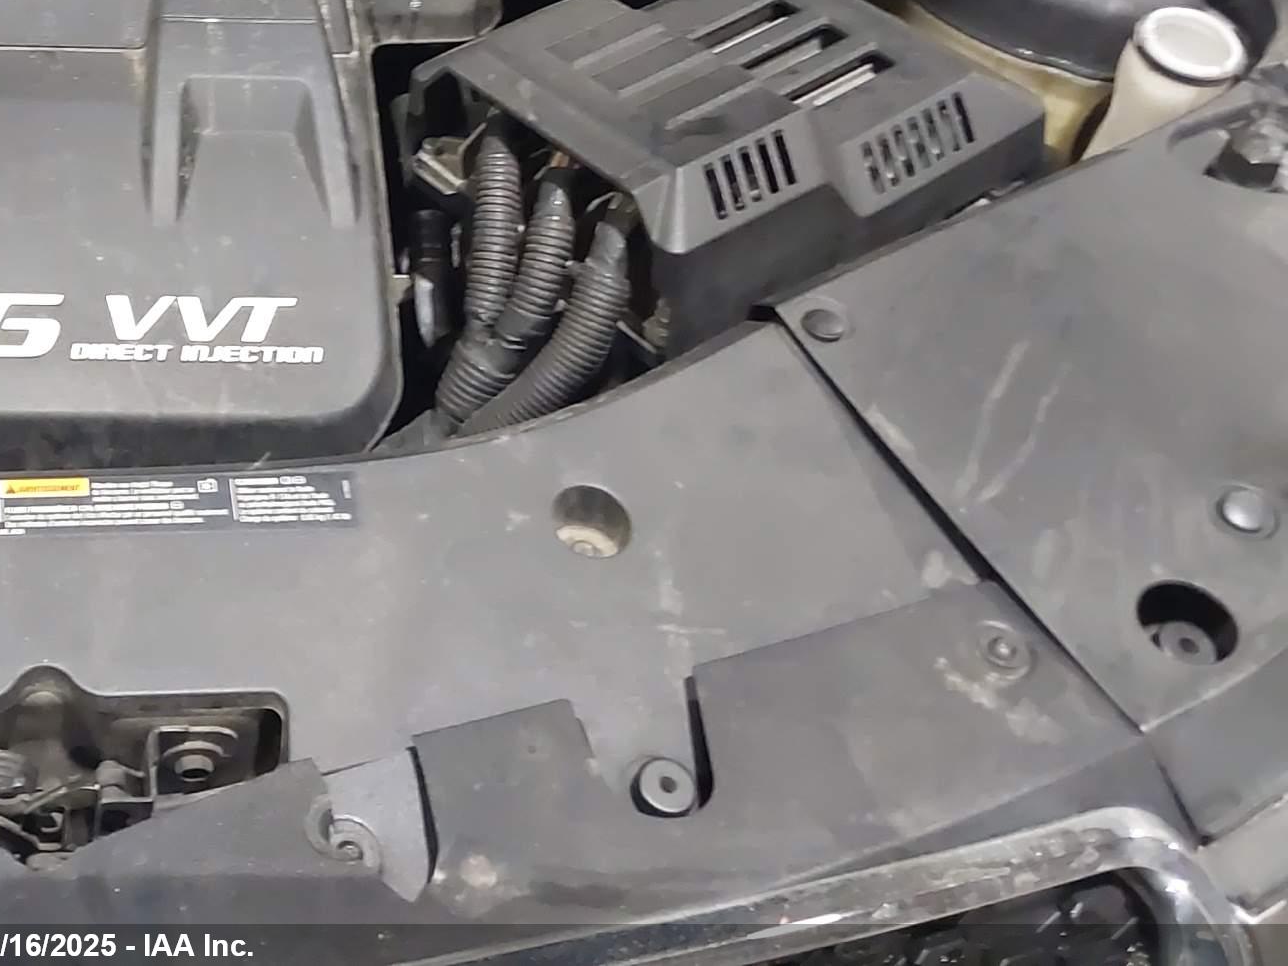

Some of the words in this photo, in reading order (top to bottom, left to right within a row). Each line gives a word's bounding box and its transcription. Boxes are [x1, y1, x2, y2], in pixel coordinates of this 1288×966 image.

[105, 294, 299, 343] VVT
[69, 343, 175, 362] DIRECT
[179, 344, 324, 364] INJECTION
